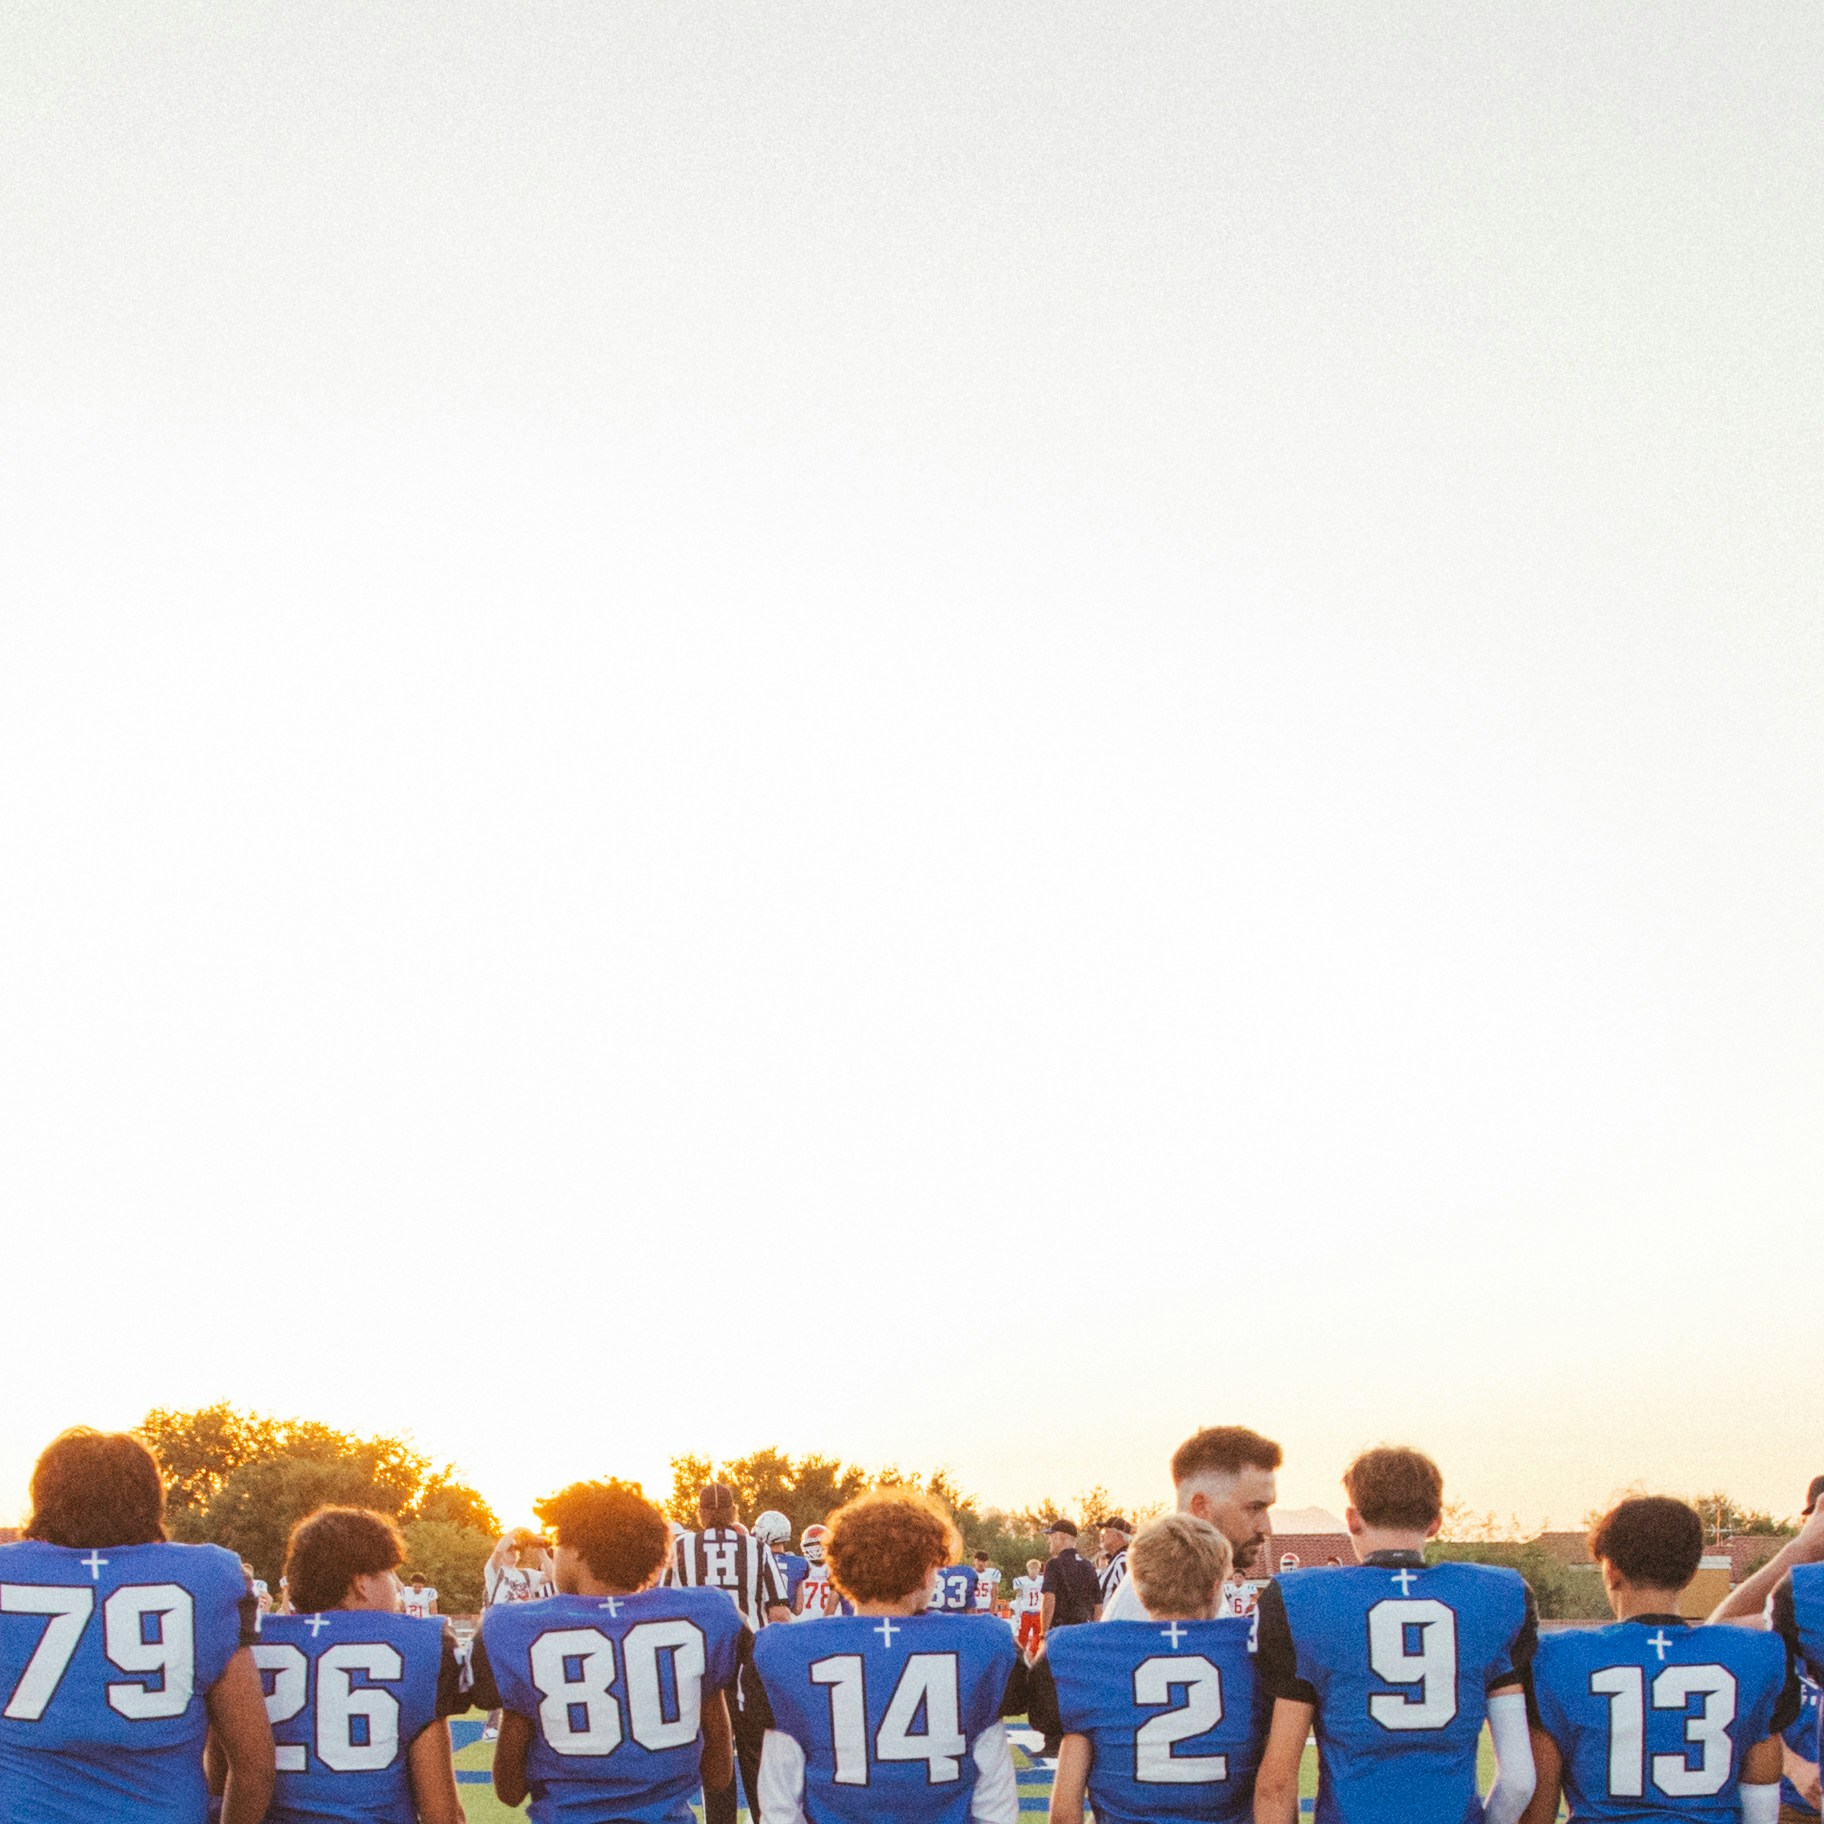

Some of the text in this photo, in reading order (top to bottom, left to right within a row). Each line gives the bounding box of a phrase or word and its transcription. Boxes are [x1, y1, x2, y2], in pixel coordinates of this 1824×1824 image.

[703, 1543, 739, 1585] H
[1234, 1598, 1243, 1614] 6
[248, 1642, 405, 1773] 26
[528, 1617, 708, 1758] 80
[808, 1650, 966, 1786] 14
[1132, 1654, 1229, 1785] 2
[1367, 1598, 1458, 1732] 9
[1588, 1663, 1739, 1798] 13
